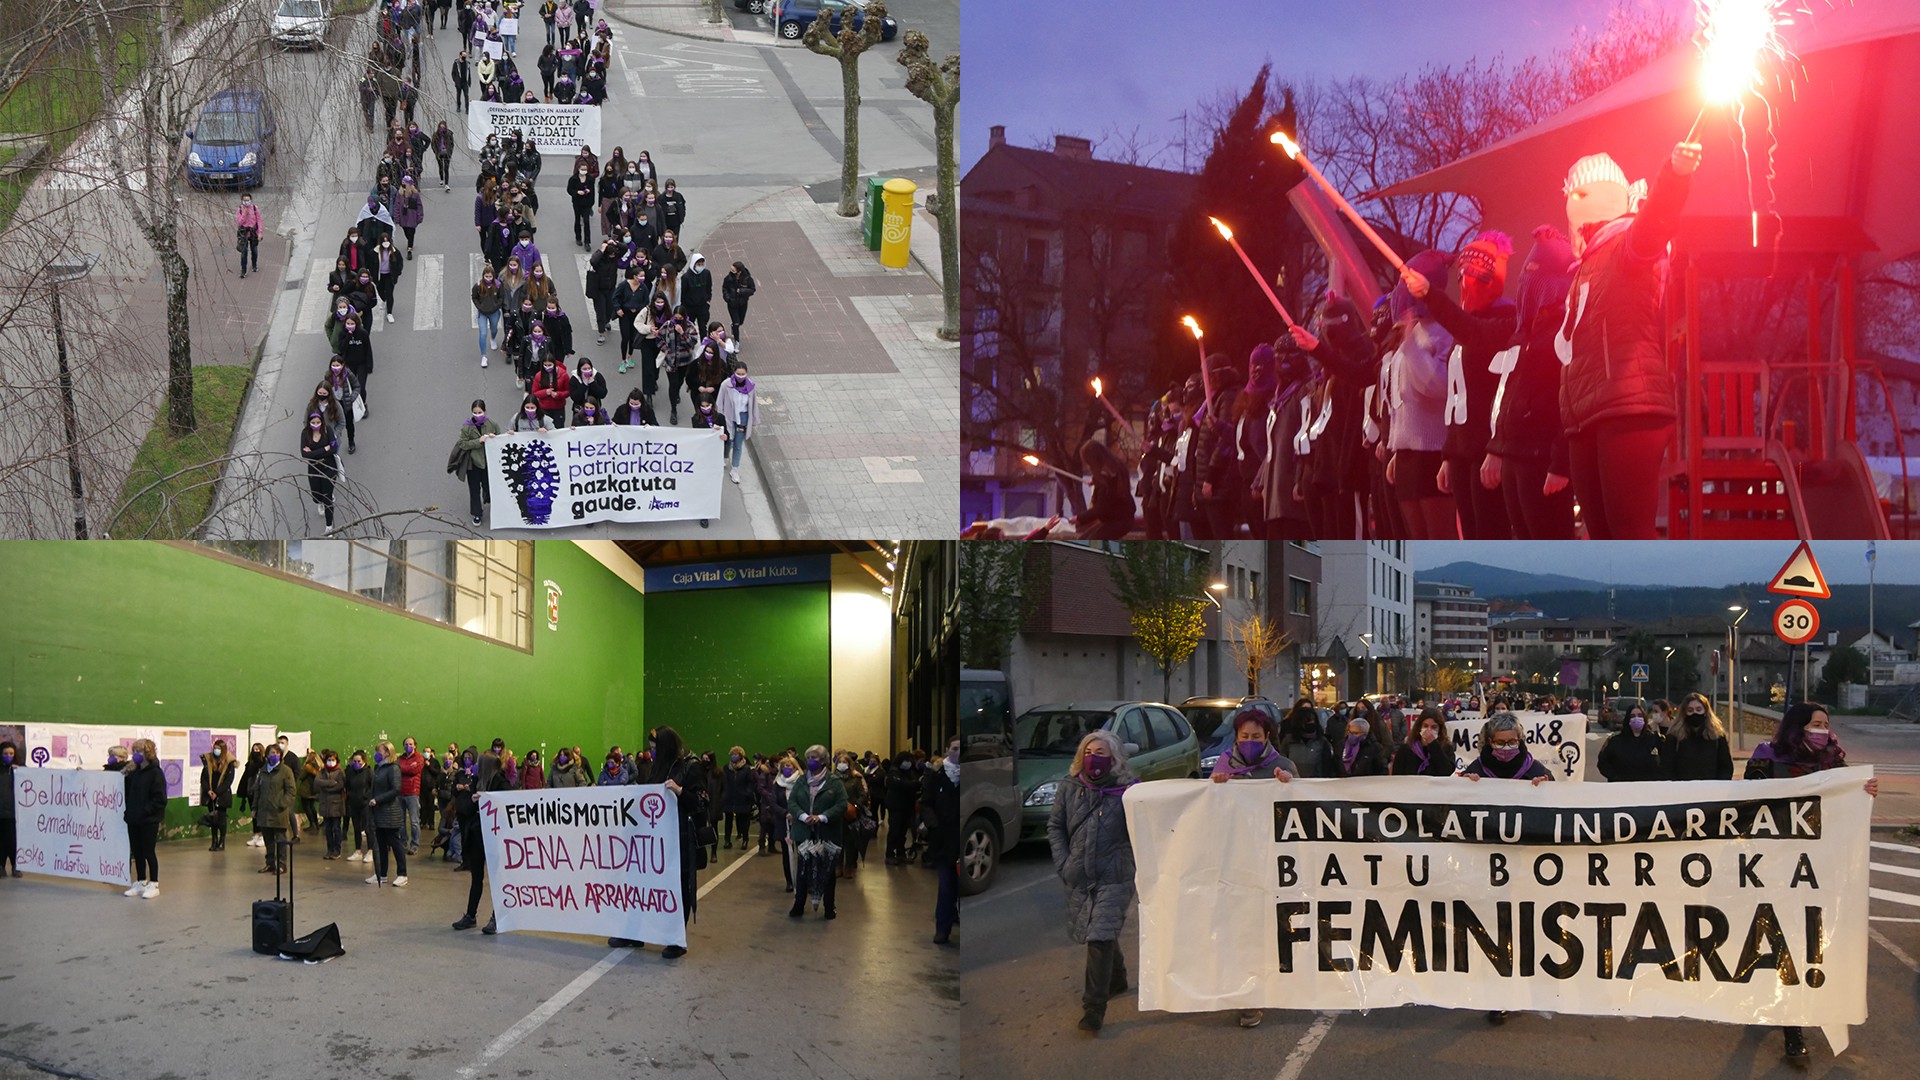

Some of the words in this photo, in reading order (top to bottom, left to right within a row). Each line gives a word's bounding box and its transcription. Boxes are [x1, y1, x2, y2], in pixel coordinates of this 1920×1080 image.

[491, 114, 580, 126] FEMINISMOTIK
[494, 126, 524, 137] DENA
[528, 126, 576, 138] ALDATU
[567, 439, 678, 458] Hezkuntza
[569, 456, 694, 481] patriarkalaz
[570, 476, 676, 496] nazkatuta
[572, 494, 641, 520] gaude.
[672, 573, 692, 584] Caja
[694, 570, 720, 582] Vital
[739, 566, 766, 578] Vital
[769, 566, 798, 576] Kutxa
[1783, 614, 1809, 629] 30
[18, 774, 90, 810] Beldurrik
[38, 814, 106, 841] emakumeak
[1281, 807, 1522, 843] ANTOLATU
[1554, 801, 1816, 844] INDARRAK
[504, 835, 574, 872] DENA
[580, 834, 666, 874] ALDATU
[1278, 853, 1429, 887] BATU
[1490, 852, 1820, 889] BORROKA
[502, 884, 579, 911] SISTEMA
[585, 882, 678, 913] ARRAKALATU
[1276, 899, 1826, 988] FEMINISTARA!
